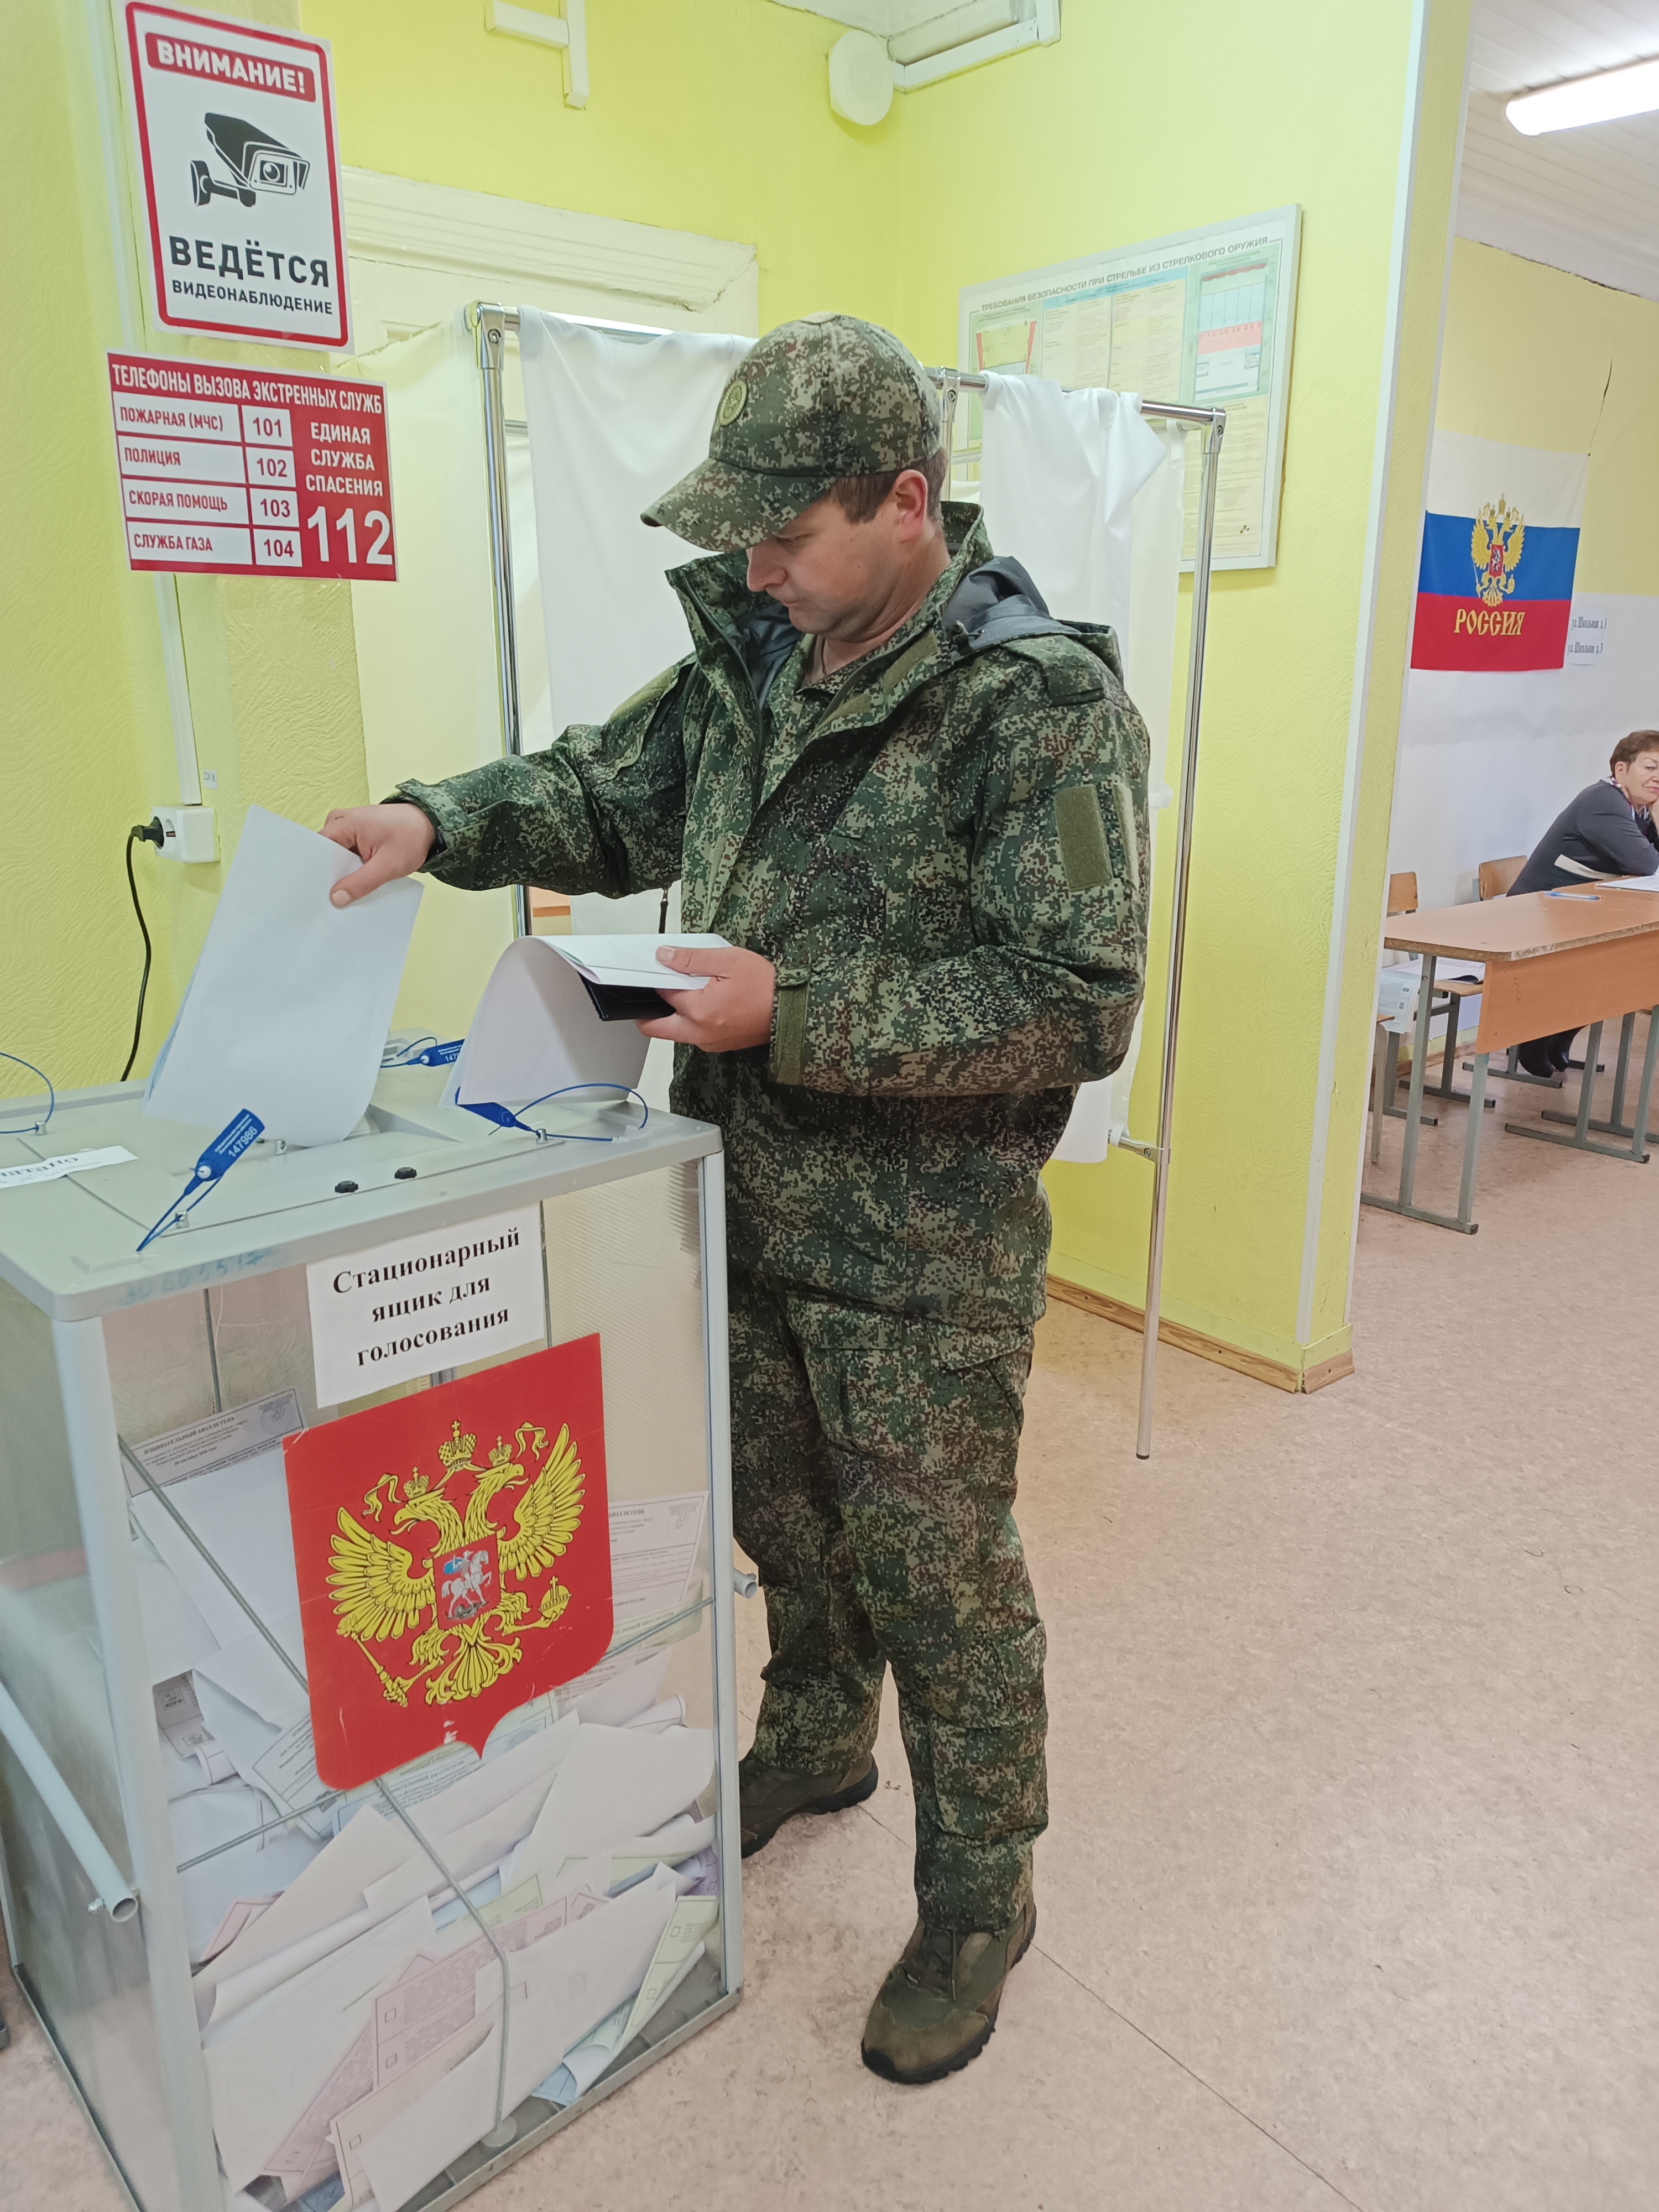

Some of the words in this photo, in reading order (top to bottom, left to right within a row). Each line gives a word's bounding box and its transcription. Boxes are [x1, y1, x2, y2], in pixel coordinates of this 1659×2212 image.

[156, 39, 306, 93] ВНИМАНИЕ!
[169, 235, 330, 288] ВЕДЁТСЯ
[981, 295, 1026, 312] ТРЕБОВАНИЯ
[1027, 281, 1087, 301] БЕЗОПАСНОСТИ
[1088, 276, 1105, 288] ПРИ
[1107, 266, 1147, 283] СТРЕЛЬБЕ
[1149, 263, 1160, 273] ИЗ
[1162, 248, 1225, 269] СТРЕЛКОВОГО
[1228, 237, 1267, 253] ОРУЖИЯ
[172, 279, 332, 315] ВИДЕОНАБЛЮДЕНИЕ
[112, 363, 190, 393] ТЕЛЕФОНЫ
[194, 377, 250, 400] ВЫЗОВА
[253, 383, 337, 408] ЭКСТРЕННЫХ
[339, 392, 383, 414] СЛУЖБ
[120, 406, 185, 426] ПОЖАРНАЯ
[189, 411, 223, 432] (МЧС)
[252, 417, 283, 438] 101
[310, 422, 371, 445] ЕДИНАЯ
[124, 447, 181, 467] ПОЛИЦИЯ
[256, 457, 288, 478] 102
[310, 448, 375, 471] СЛУЖБА
[305, 475, 383, 497] СПАСЕНИЯ
[129, 491, 174, 508] СКОРАЯ
[176, 493, 228, 512] ПОМОЩЬ
[260, 499, 291, 518] 103
[134, 534, 183, 550] СЛУЖБА
[186, 536, 213, 552] ГАЗА
[263, 539, 294, 558] 104
[307, 505, 393, 565] 112
[1454, 608, 1526, 636] РОССИЯ
[228, 1126, 258, 1157] 147986
[333, 1227, 520, 1294] Стационарный
[372, 1290, 442, 1323] ящик
[449, 1276, 491, 1305] для
[357, 1307, 509, 1367] голосования
